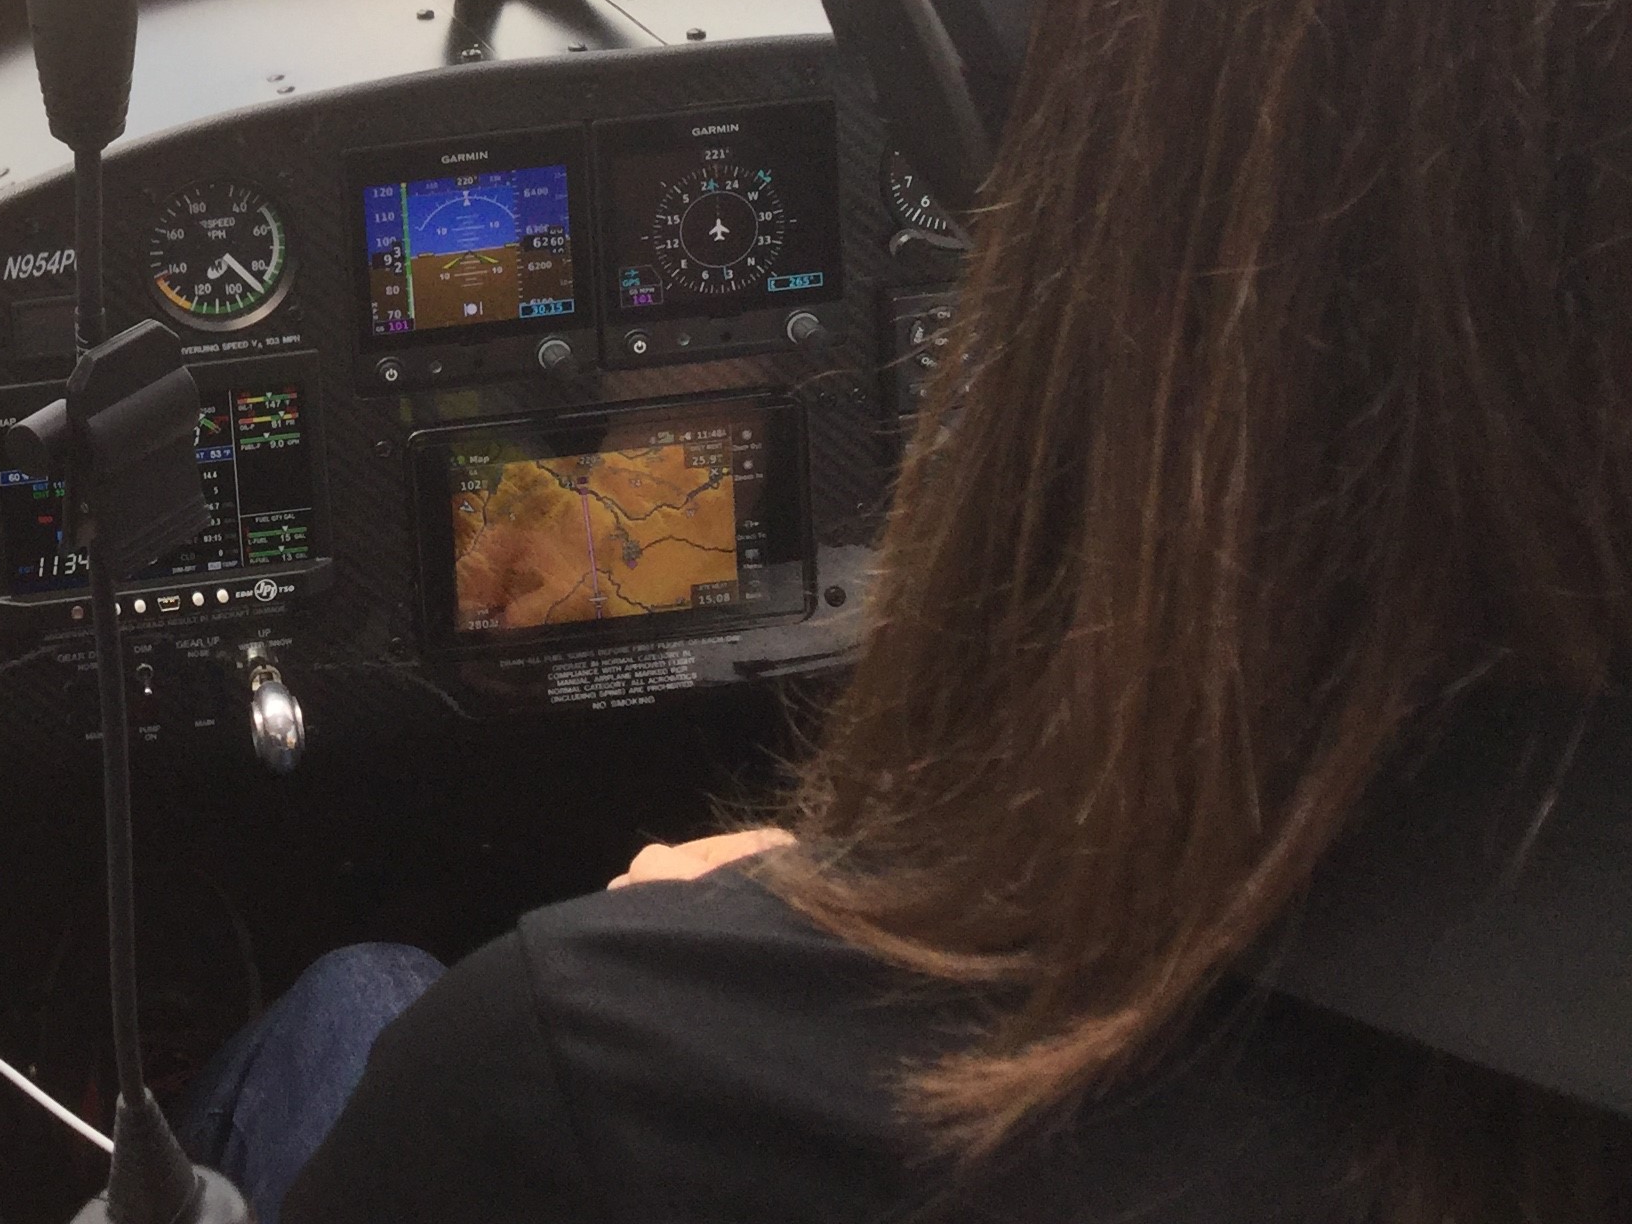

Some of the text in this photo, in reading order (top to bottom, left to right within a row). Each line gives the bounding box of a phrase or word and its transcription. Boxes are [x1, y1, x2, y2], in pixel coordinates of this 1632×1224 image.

[692, 124, 739, 137] GARMIN
[441, 151, 488, 164] GARMIN
[726, 180, 739, 189] 24
[904, 176, 912, 188] 7
[373, 188, 393, 198] 120
[748, 192, 758, 200] W
[921, 195, 930, 207] 6
[189, 201, 207, 215] 180
[232, 201, 247, 213] 40
[375, 213, 394, 222] 110
[668, 215, 680, 225] 15
[759, 212, 772, 221] 30
[167, 229, 185, 240] 160
[253, 225, 267, 237] 60
[666, 239, 679, 248] 12
[758, 236, 771, 245] 33
[3, 249, 78, 280] N954P
[252, 260, 265, 271] 80
[528, 260, 552, 271] 6200
[681, 260, 688, 268] E
[747, 257, 755, 266] N
[169, 263, 187, 274] 140
[702, 270, 709, 279] 6
[623, 278, 641, 287] GPS
[195, 283, 211, 294] 120
[226, 283, 242, 294] 100
[386, 286, 399, 295] 80
[388, 310, 401, 320] 70
[389, 321, 408, 330] 101
[282, 335, 300, 344] MPH
[265, 400, 281, 408] 147
[270, 440, 284, 448] 9.0
[9, 473, 20, 482] 60
[461, 480, 481, 492] 102
[258, 628, 271, 638] UP
[176, 638, 204, 649] GEAR
[134, 644, 152, 654] DIM
[592, 695, 655, 710] NO SMOKING
